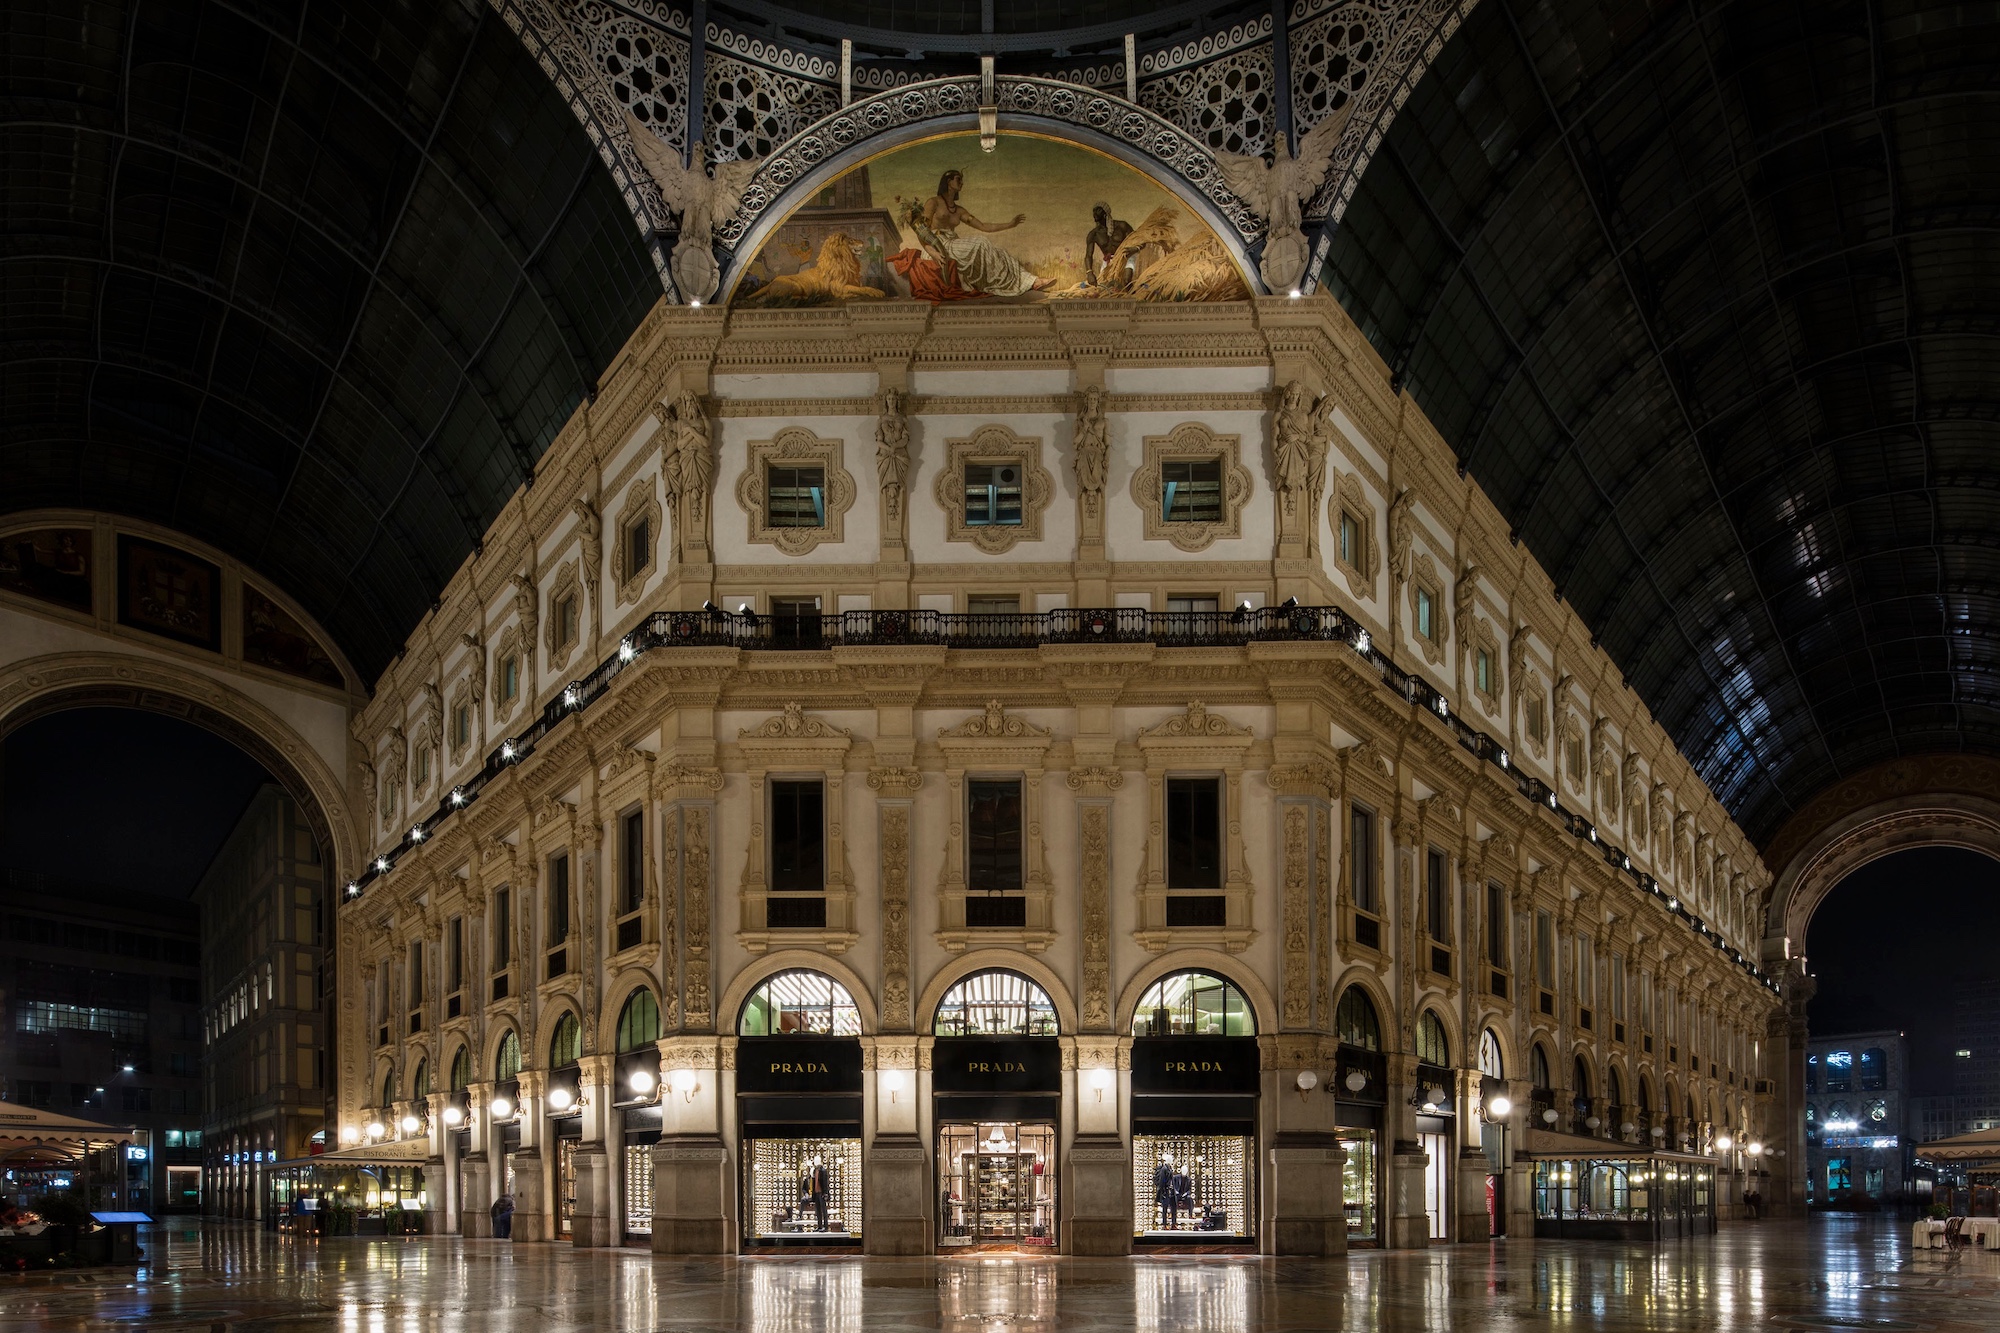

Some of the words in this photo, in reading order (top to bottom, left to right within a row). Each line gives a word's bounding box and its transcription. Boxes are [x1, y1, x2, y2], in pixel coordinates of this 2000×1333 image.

[771, 1063, 828, 1073] PRADA
[968, 1062, 1026, 1072] PRADA
[1166, 1062, 1222, 1072] PRADA
